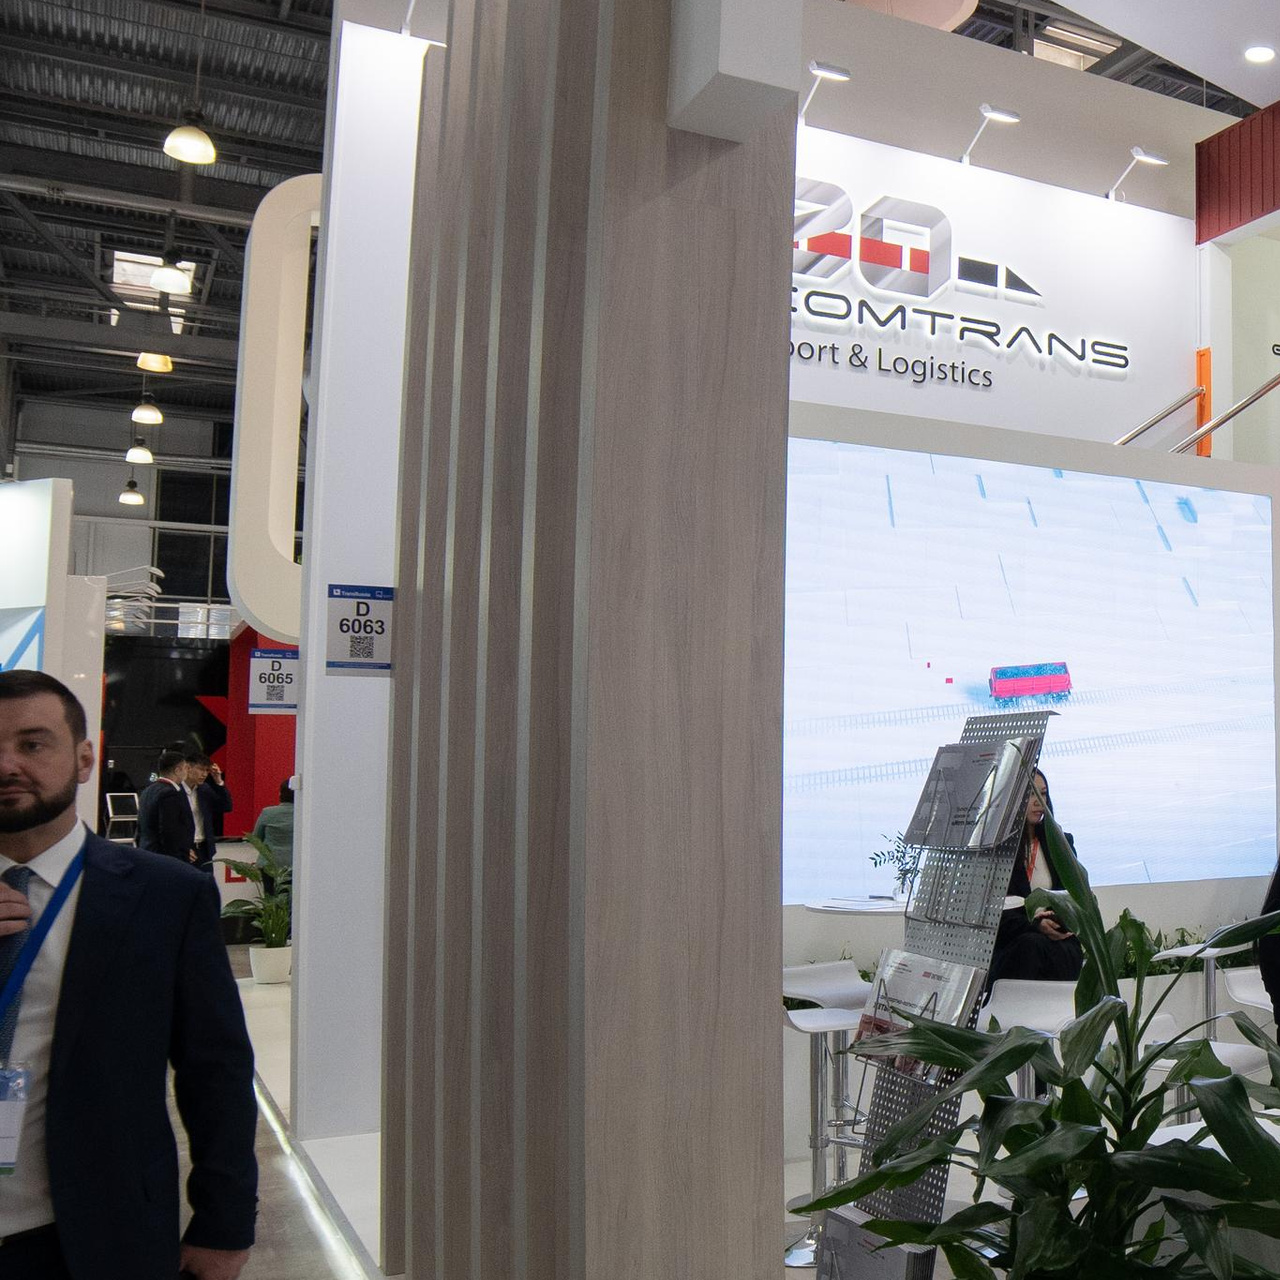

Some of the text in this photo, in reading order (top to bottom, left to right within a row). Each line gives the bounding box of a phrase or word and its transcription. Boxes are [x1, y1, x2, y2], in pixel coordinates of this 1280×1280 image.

[791, 286, 1130, 369] OMTRANS
[848, 343, 868, 369] &
[877, 347, 993, 388] Logistics
[356, 601, 370, 616] D
[339, 618, 385, 635] 6063
[271, 660, 282, 672] D
[258, 672, 293, 685] 6065
